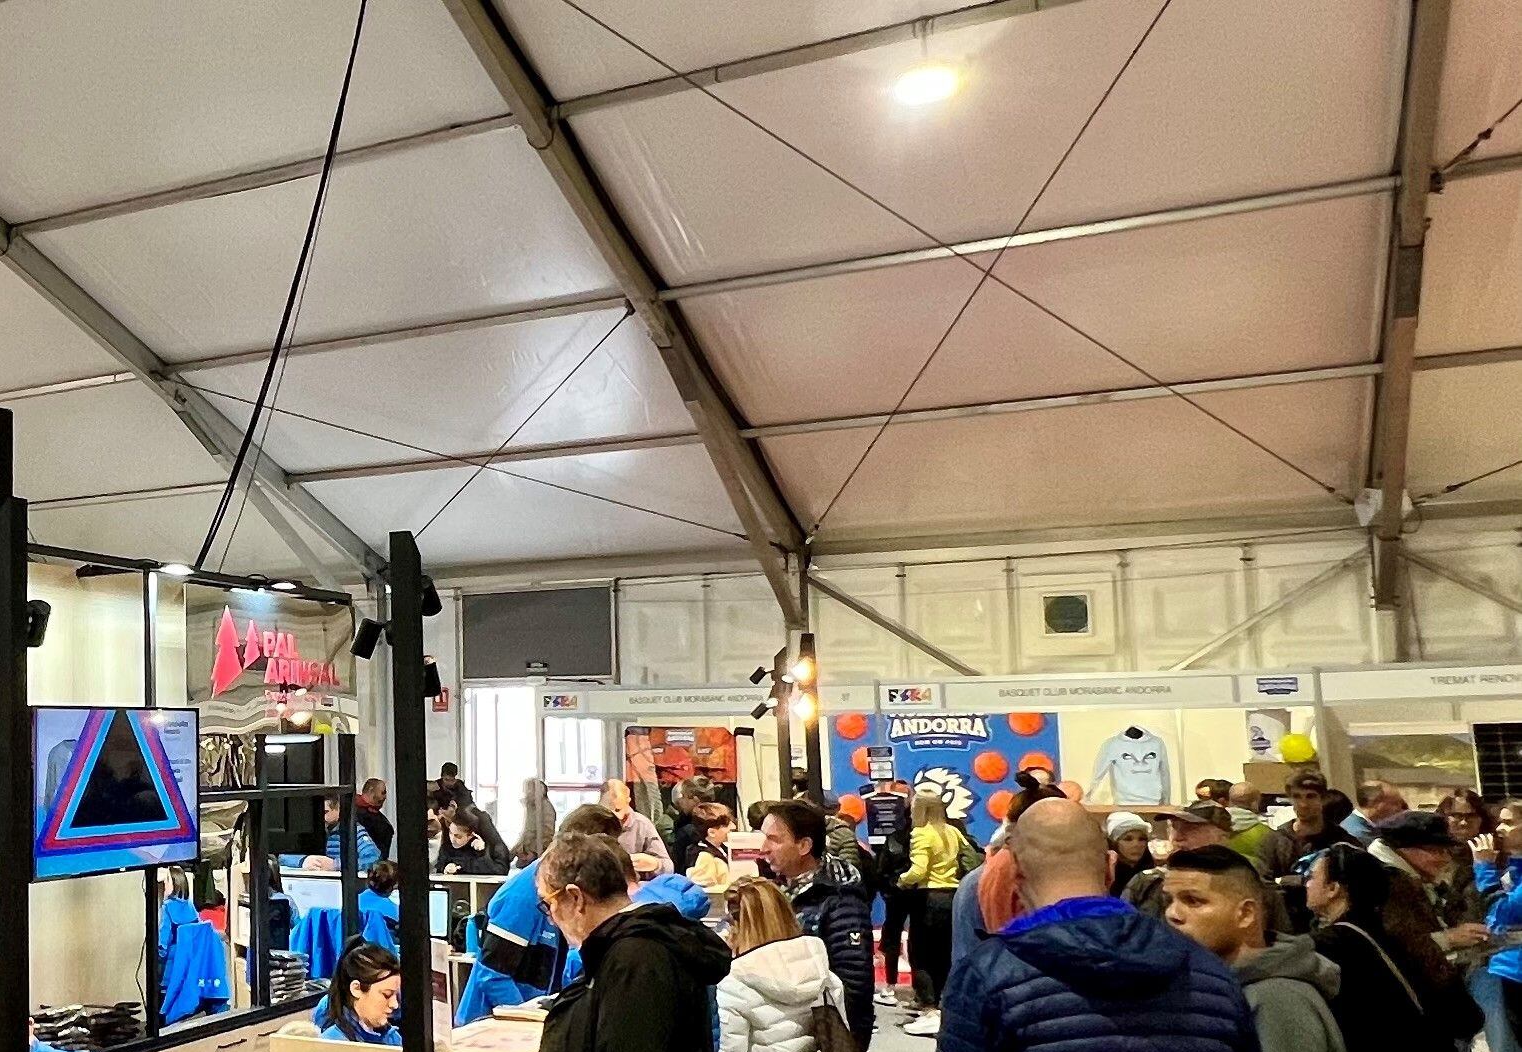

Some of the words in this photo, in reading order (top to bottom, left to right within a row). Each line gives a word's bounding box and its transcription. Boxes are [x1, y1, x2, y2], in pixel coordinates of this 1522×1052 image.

[263, 631, 299, 658] PAL
[1042, 687, 1068, 697] CLUB
[890, 717, 987, 738] ANDORRA
